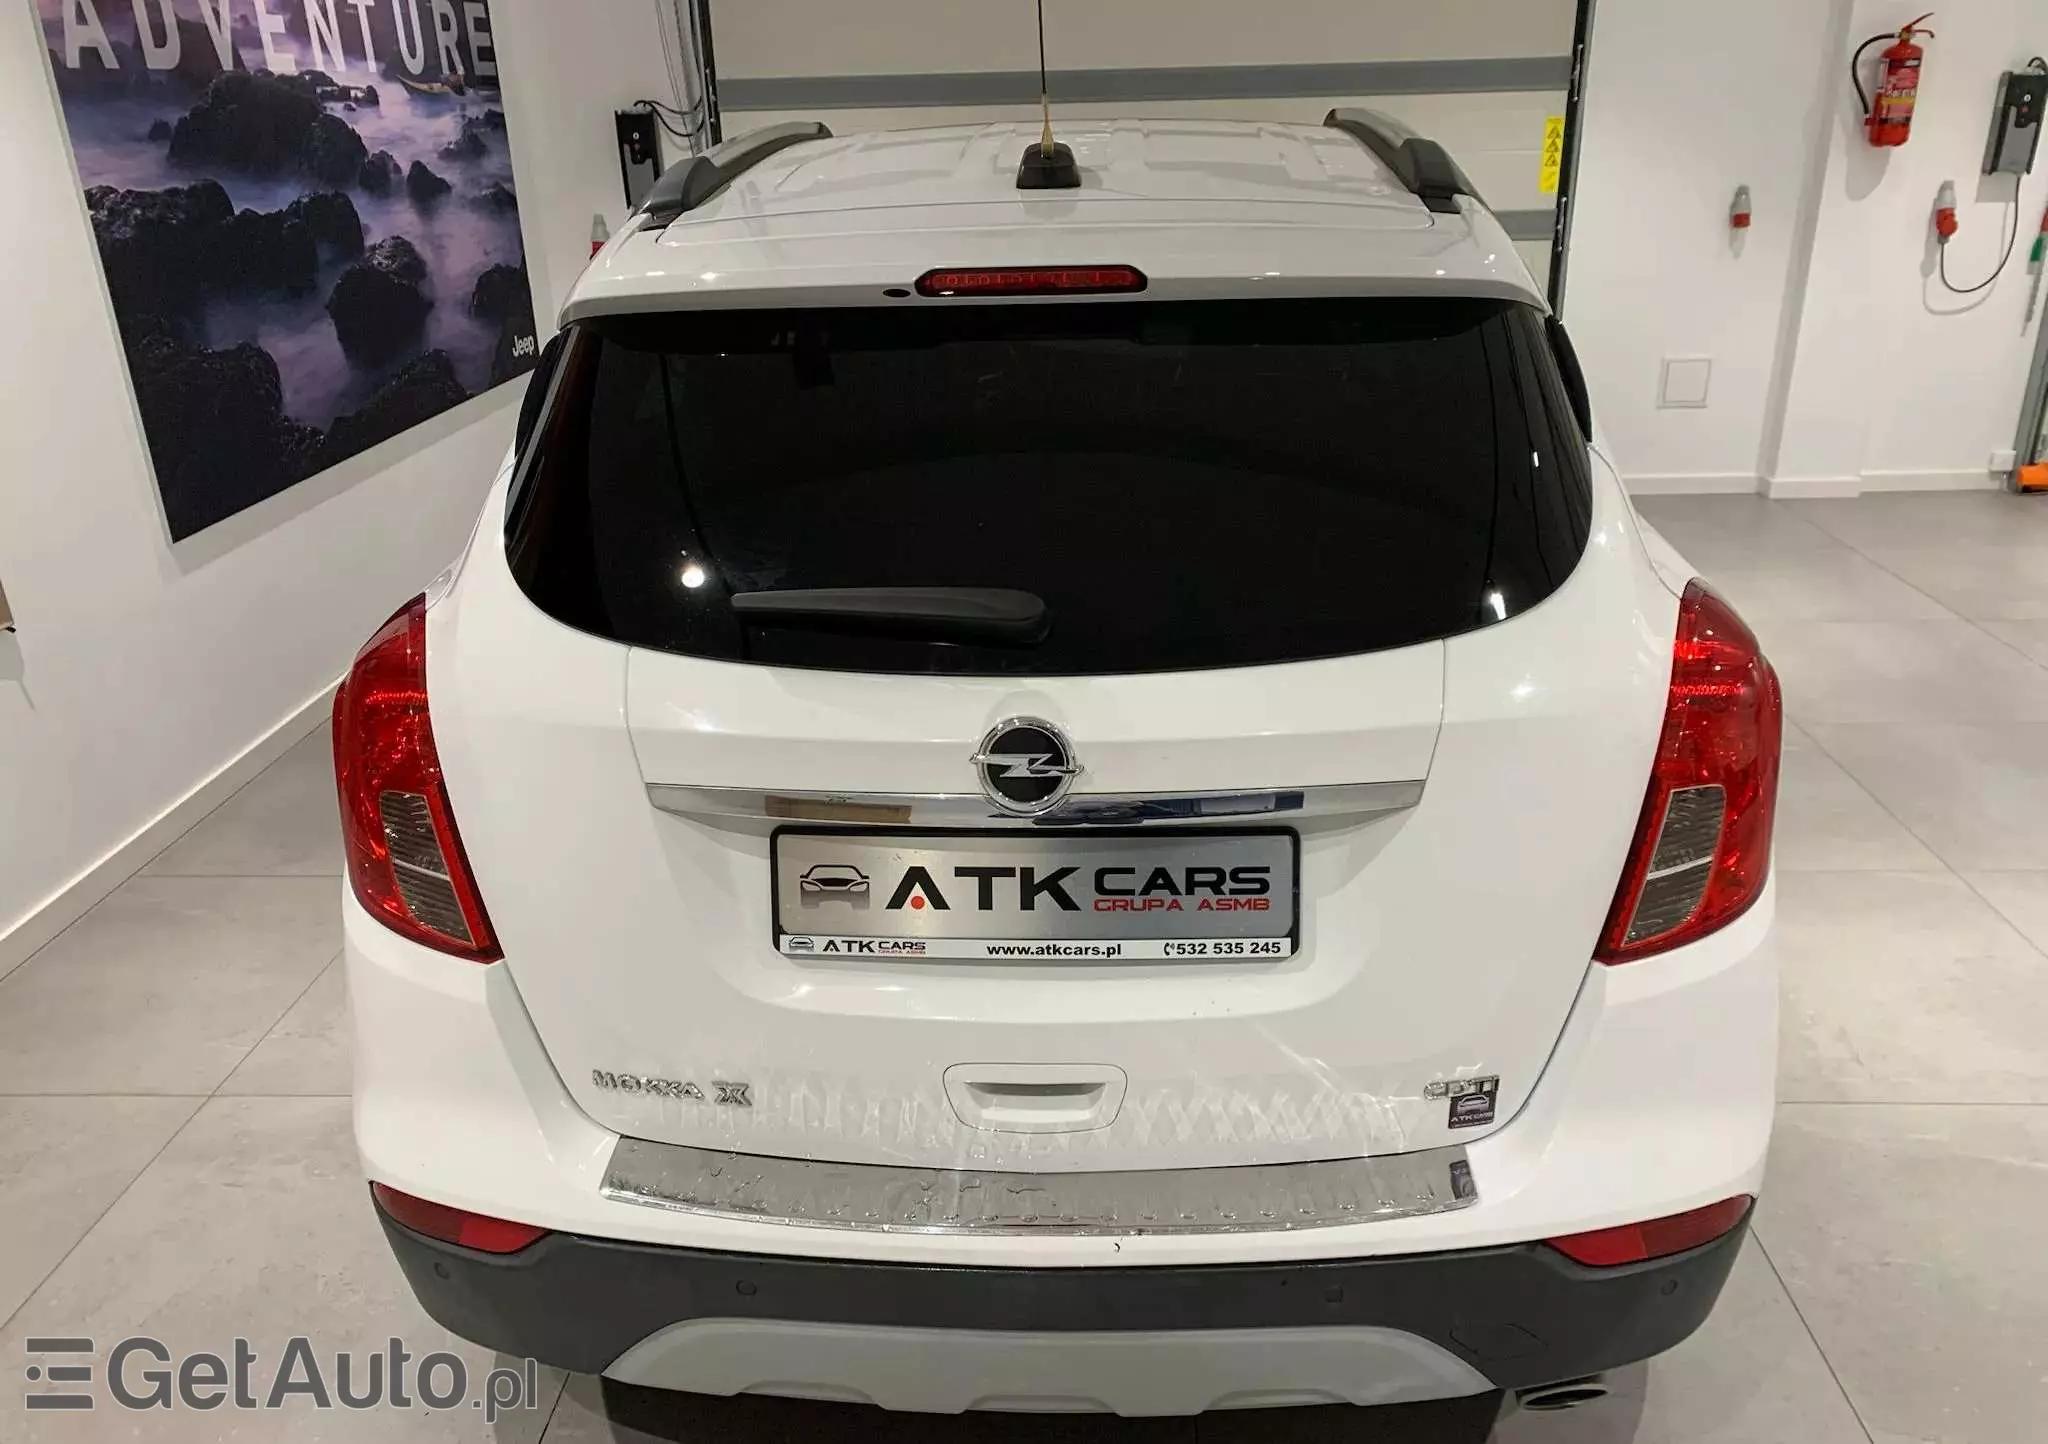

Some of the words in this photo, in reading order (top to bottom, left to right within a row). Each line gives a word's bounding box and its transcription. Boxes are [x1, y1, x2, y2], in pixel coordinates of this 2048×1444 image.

[61, 0, 497, 77] ADVENTURE
[512, 335, 534, 357] Jeep
[884, 866, 1081, 911] ATK
[1094, 866, 1271, 896] CARS
[1094, 899, 1184, 912] GRUPA
[1197, 898, 1271, 912] ASMB
[823, 939, 875, 953] ATK
[878, 941, 926, 951] CARS
[986, 943, 1122, 958] www.atkcars.pl
[1176, 942, 1207, 955] 532
[1213, 942, 1244, 954] 535
[1250, 941, 1281, 954] 245
[592, 1069, 705, 1101] MOKKA
